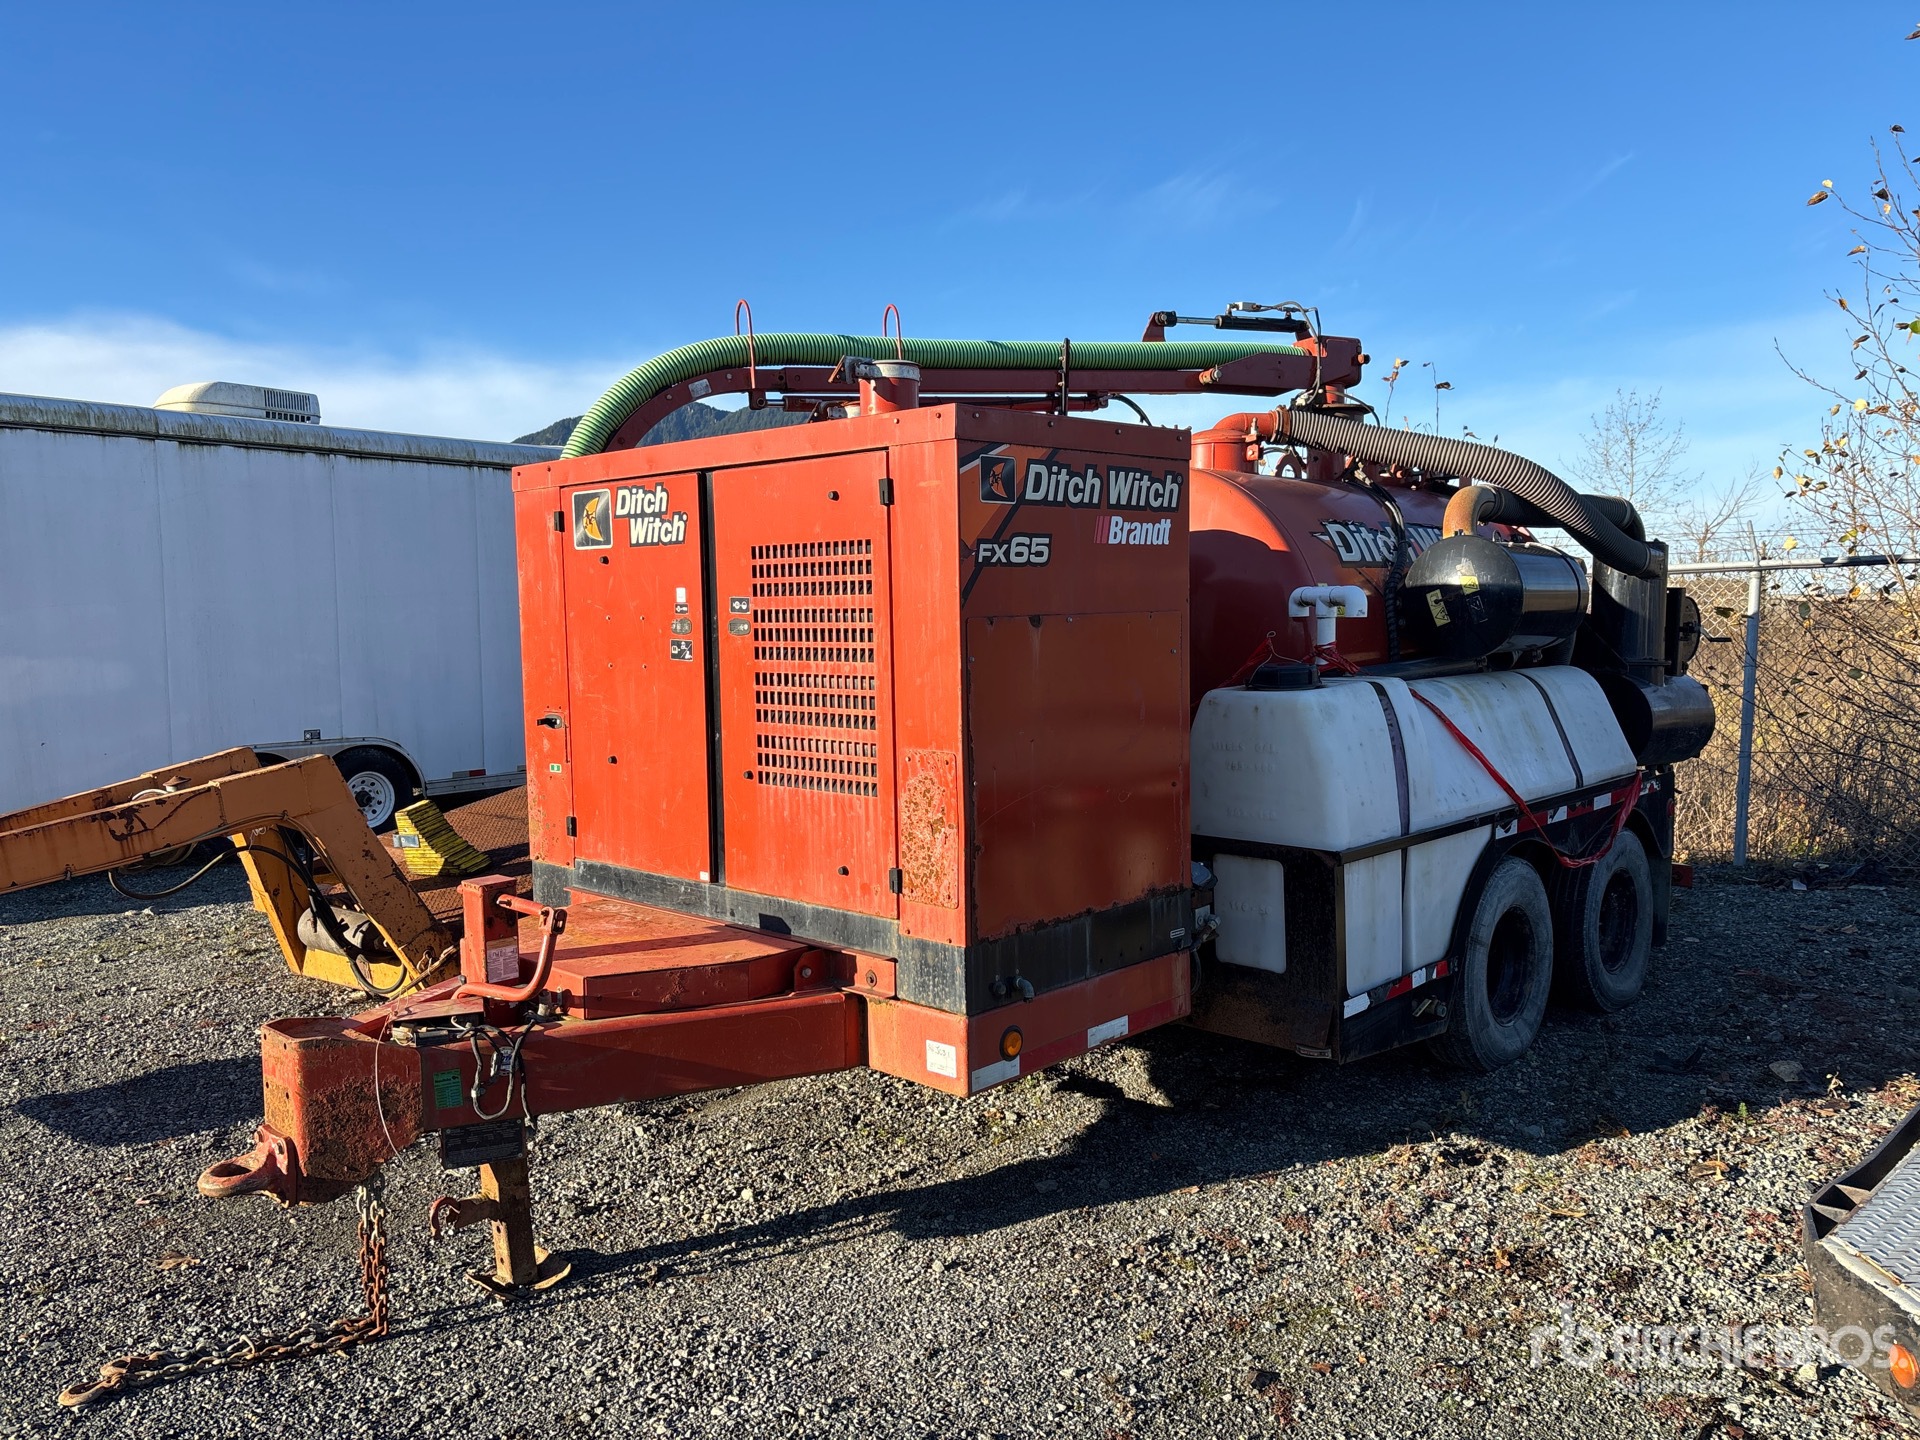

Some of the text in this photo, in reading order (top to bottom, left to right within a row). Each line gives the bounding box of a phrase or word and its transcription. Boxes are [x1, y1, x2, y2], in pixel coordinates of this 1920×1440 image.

[1025, 463, 1100, 504] Ditch
[615, 485, 668, 516] Ditch
[1107, 515, 1172, 546] Brandt
[977, 536, 1050, 564] FX65
